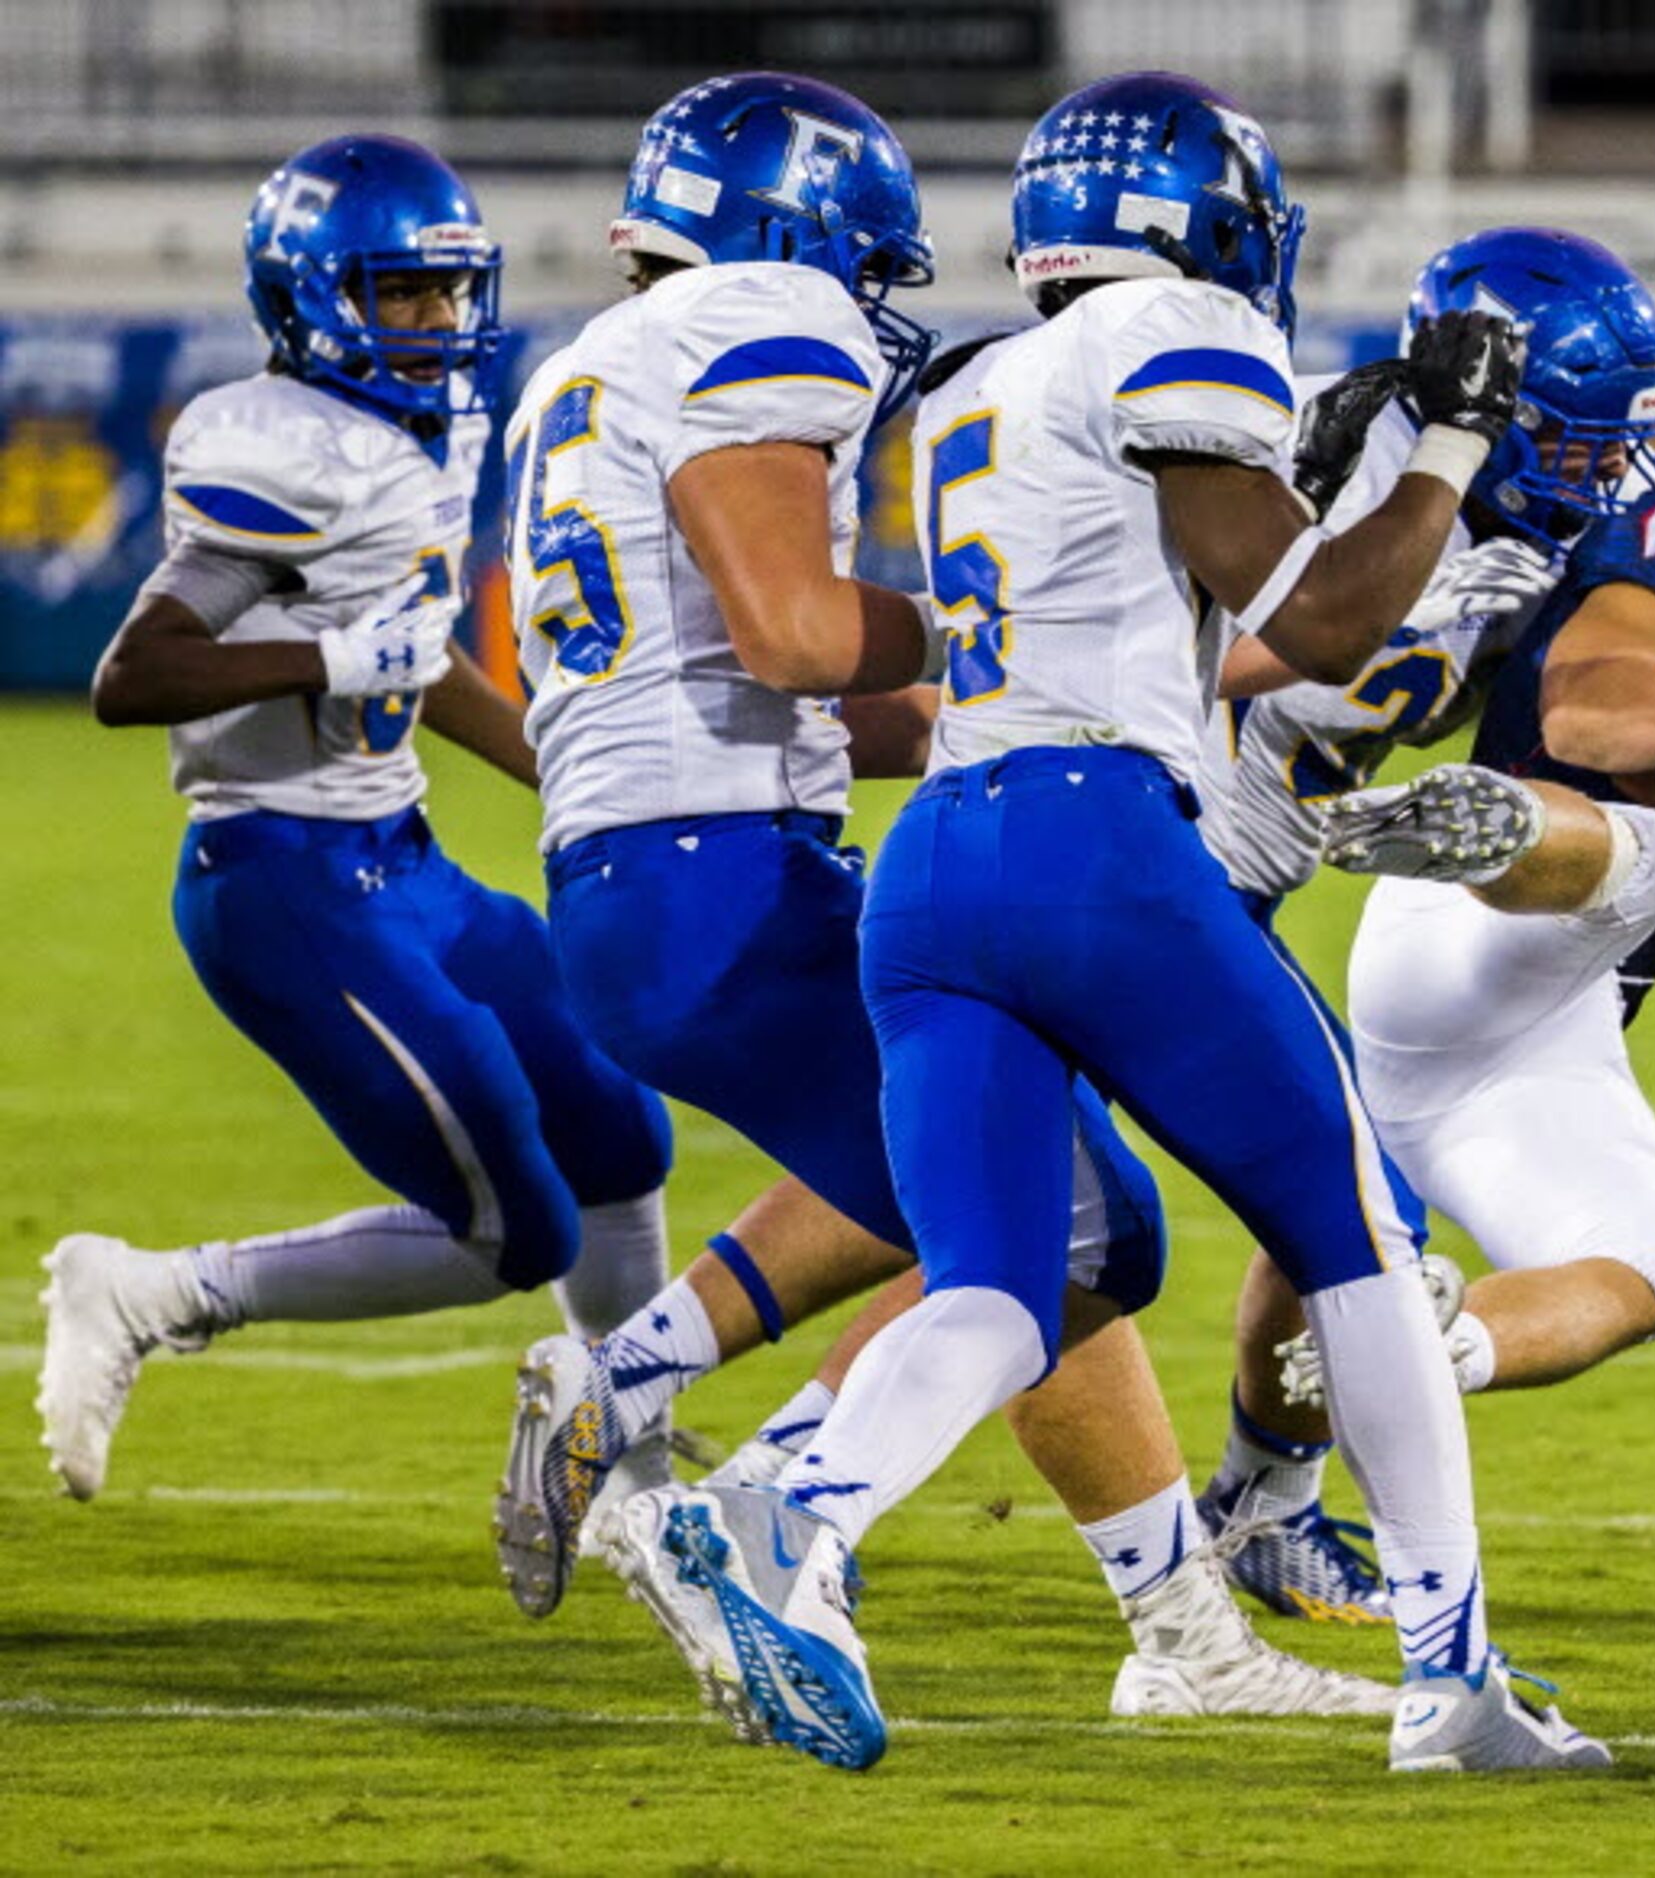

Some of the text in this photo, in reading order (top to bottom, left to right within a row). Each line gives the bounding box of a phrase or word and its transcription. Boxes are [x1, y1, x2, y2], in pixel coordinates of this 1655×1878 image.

[746, 106, 864, 219] F
[1072, 186, 1089, 211] 5
[254, 173, 343, 263] F
[928, 407, 1014, 709] 5
